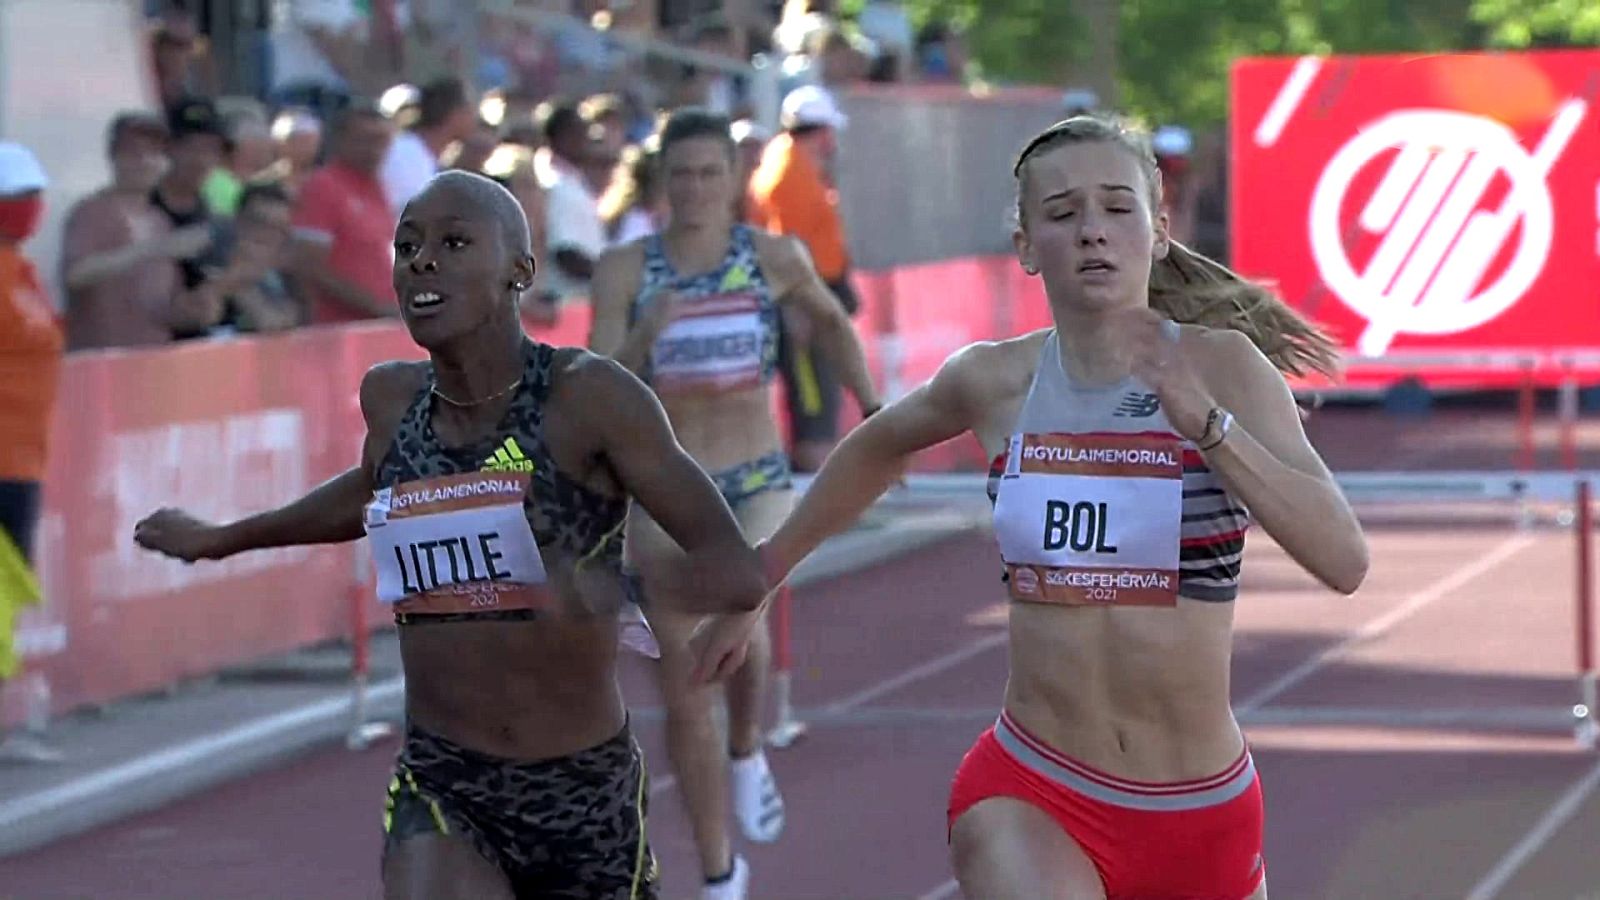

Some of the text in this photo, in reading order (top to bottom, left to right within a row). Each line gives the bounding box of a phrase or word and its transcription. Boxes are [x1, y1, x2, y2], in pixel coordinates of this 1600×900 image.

[1023, 446, 1178, 466] #GYULAIMEMORIAL
[391, 479, 522, 507] #GYULAIMEMORIAL
[1043, 499, 1118, 554] BOL
[394, 532, 512, 595] LITTLE
[469, 591, 500, 607] 2021
[1084, 588, 1118, 600] 2021
